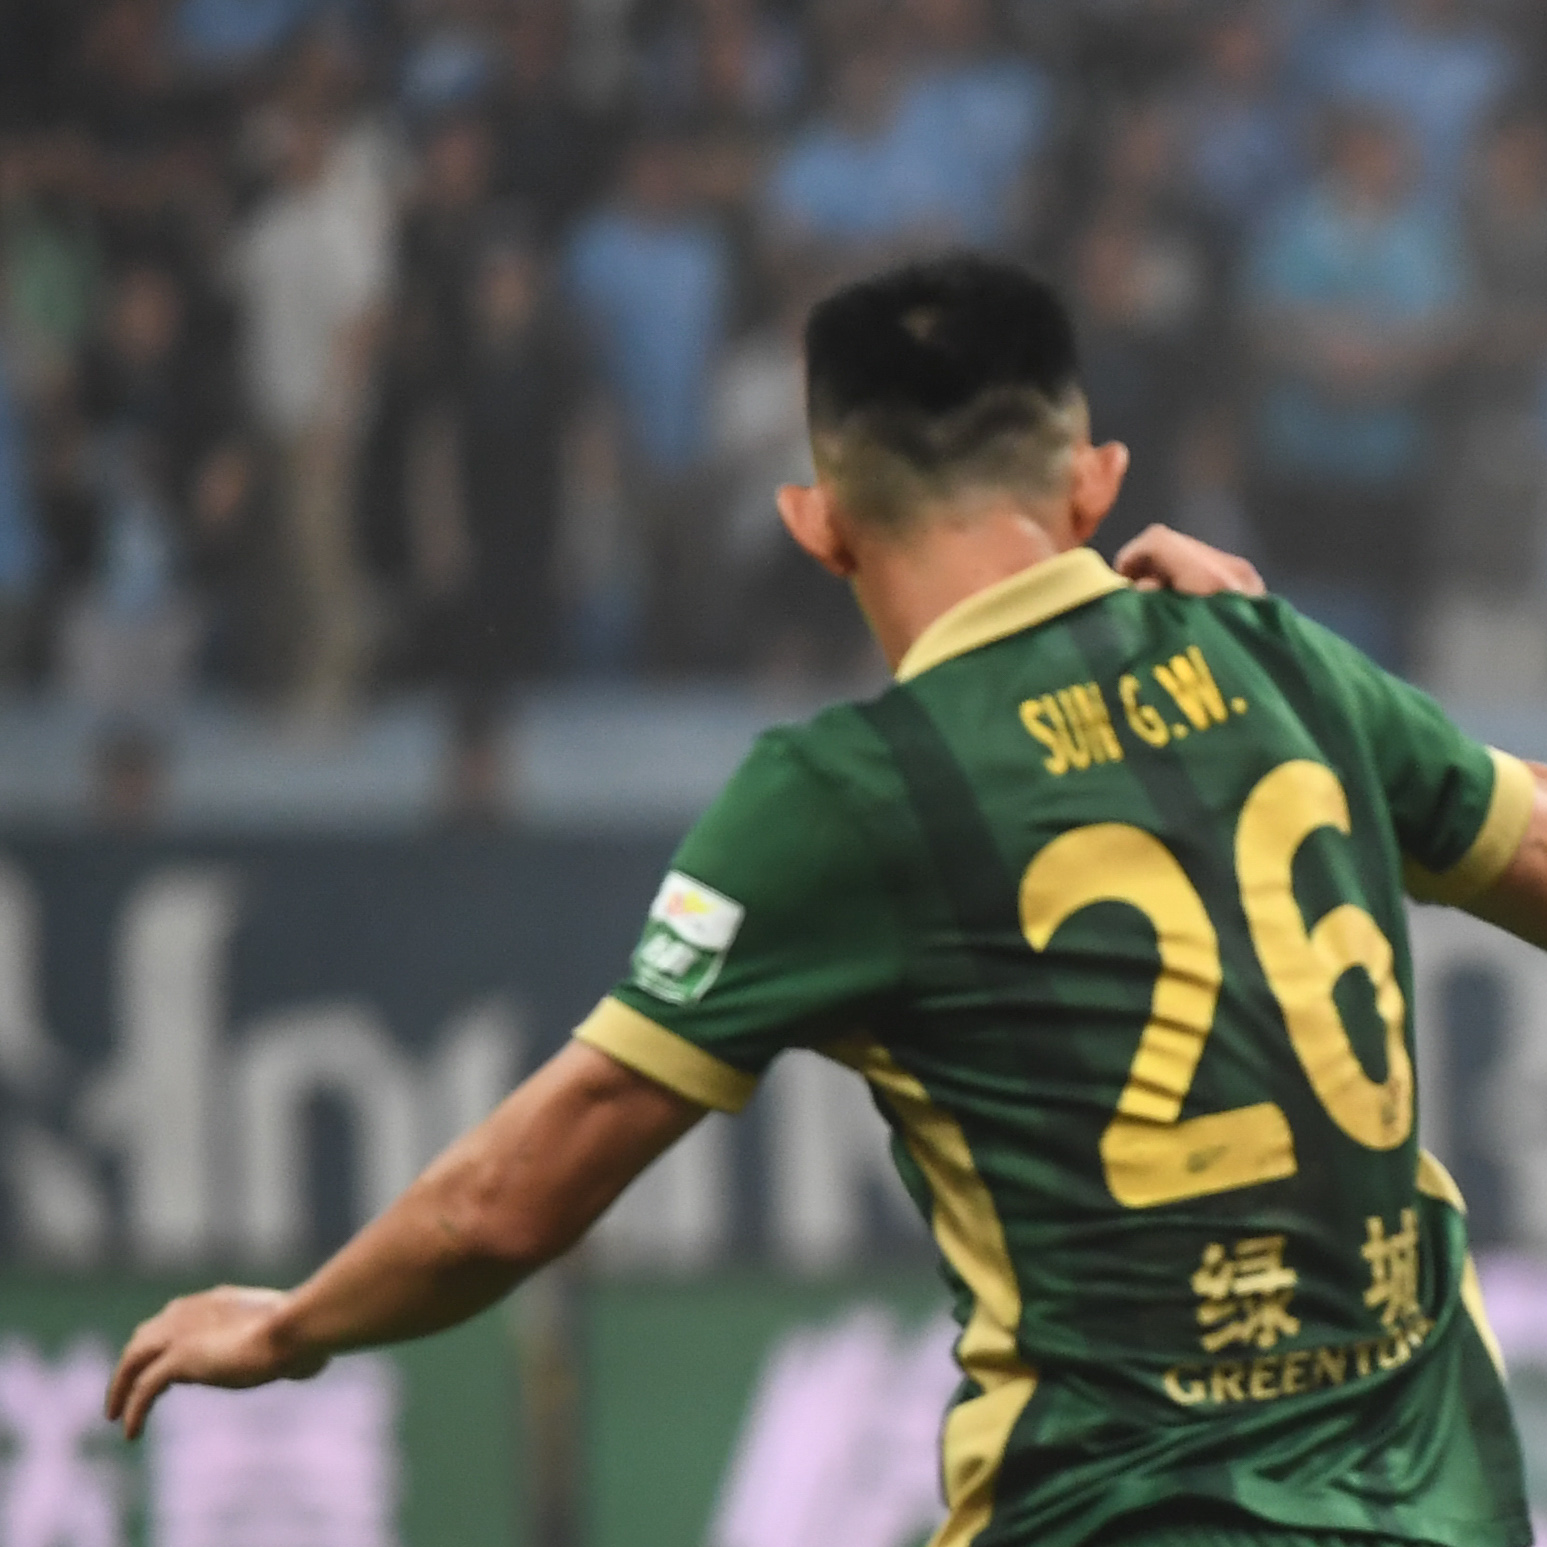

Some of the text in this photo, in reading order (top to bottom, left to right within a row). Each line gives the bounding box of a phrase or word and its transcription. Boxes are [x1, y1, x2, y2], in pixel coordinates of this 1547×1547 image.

[1019, 646, 1249, 776] SUN G.W.
[1019, 759, 1415, 1208] 26
[1163, 1336, 1414, 1406] GREENTO
